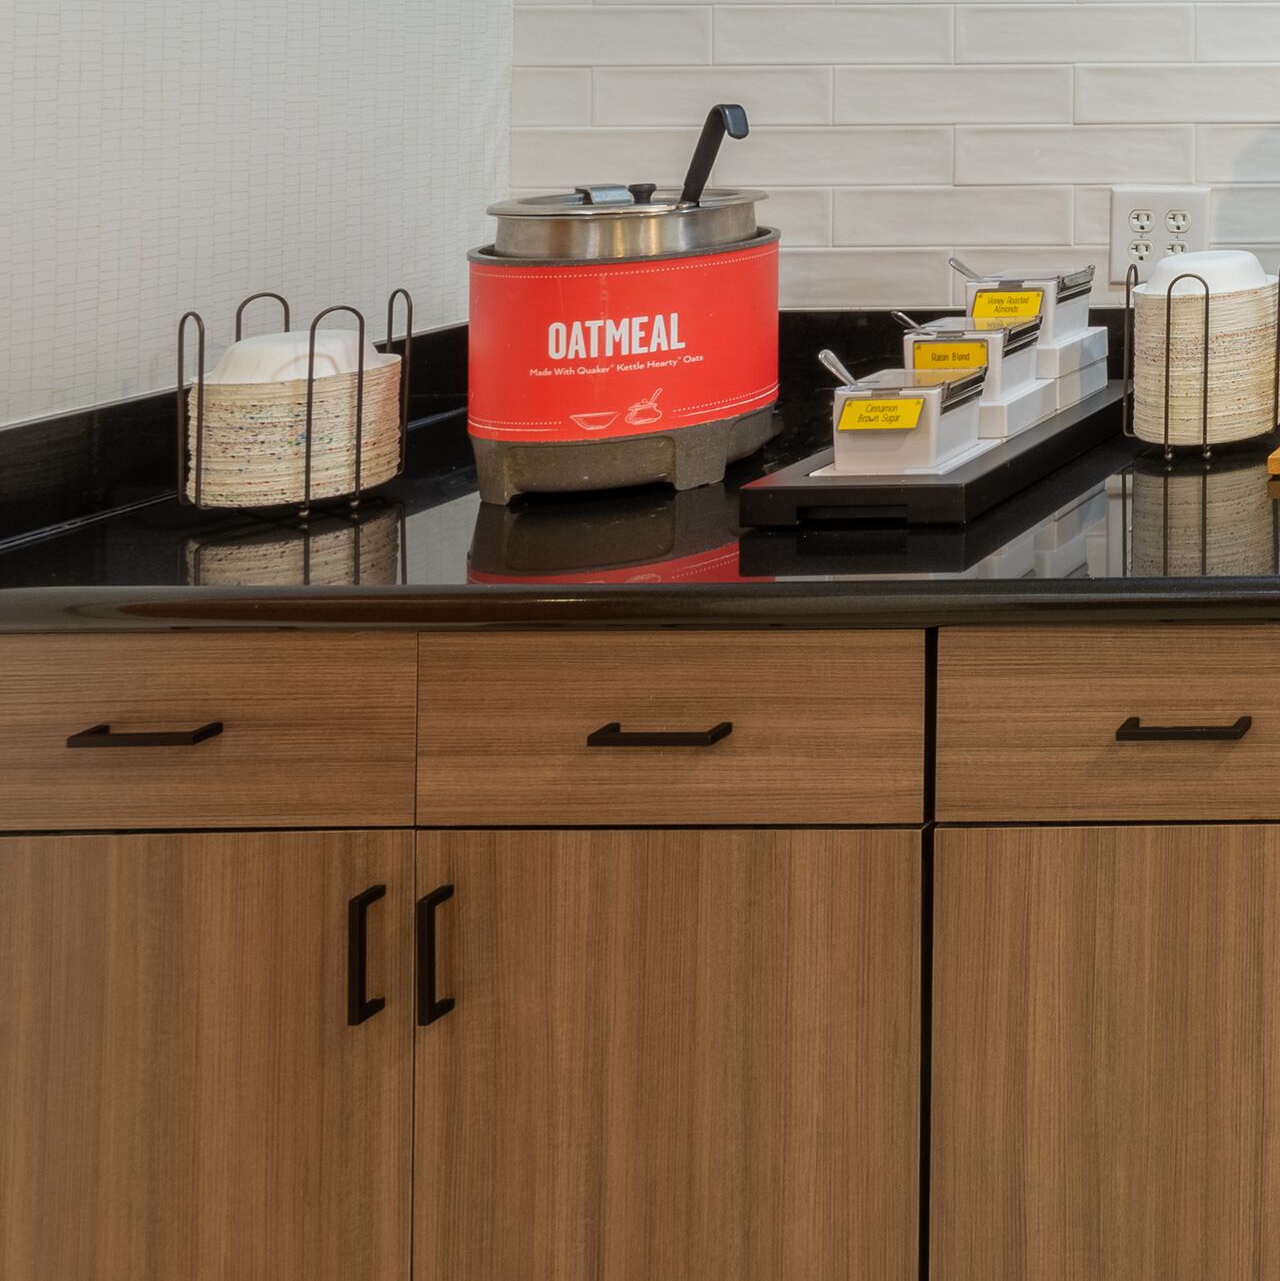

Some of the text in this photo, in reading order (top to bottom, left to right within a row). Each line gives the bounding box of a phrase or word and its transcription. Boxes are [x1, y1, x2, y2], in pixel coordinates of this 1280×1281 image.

[548, 313, 686, 359] OATMEAL
[529, 368, 552, 377] Made
[554, 367, 576, 376] With
[616, 362, 645, 372] Kettle
[683, 355, 704, 364] Oats
[866, 405, 898, 413] Cinnamon
[858, 414, 901, 424] Brown Sugar
